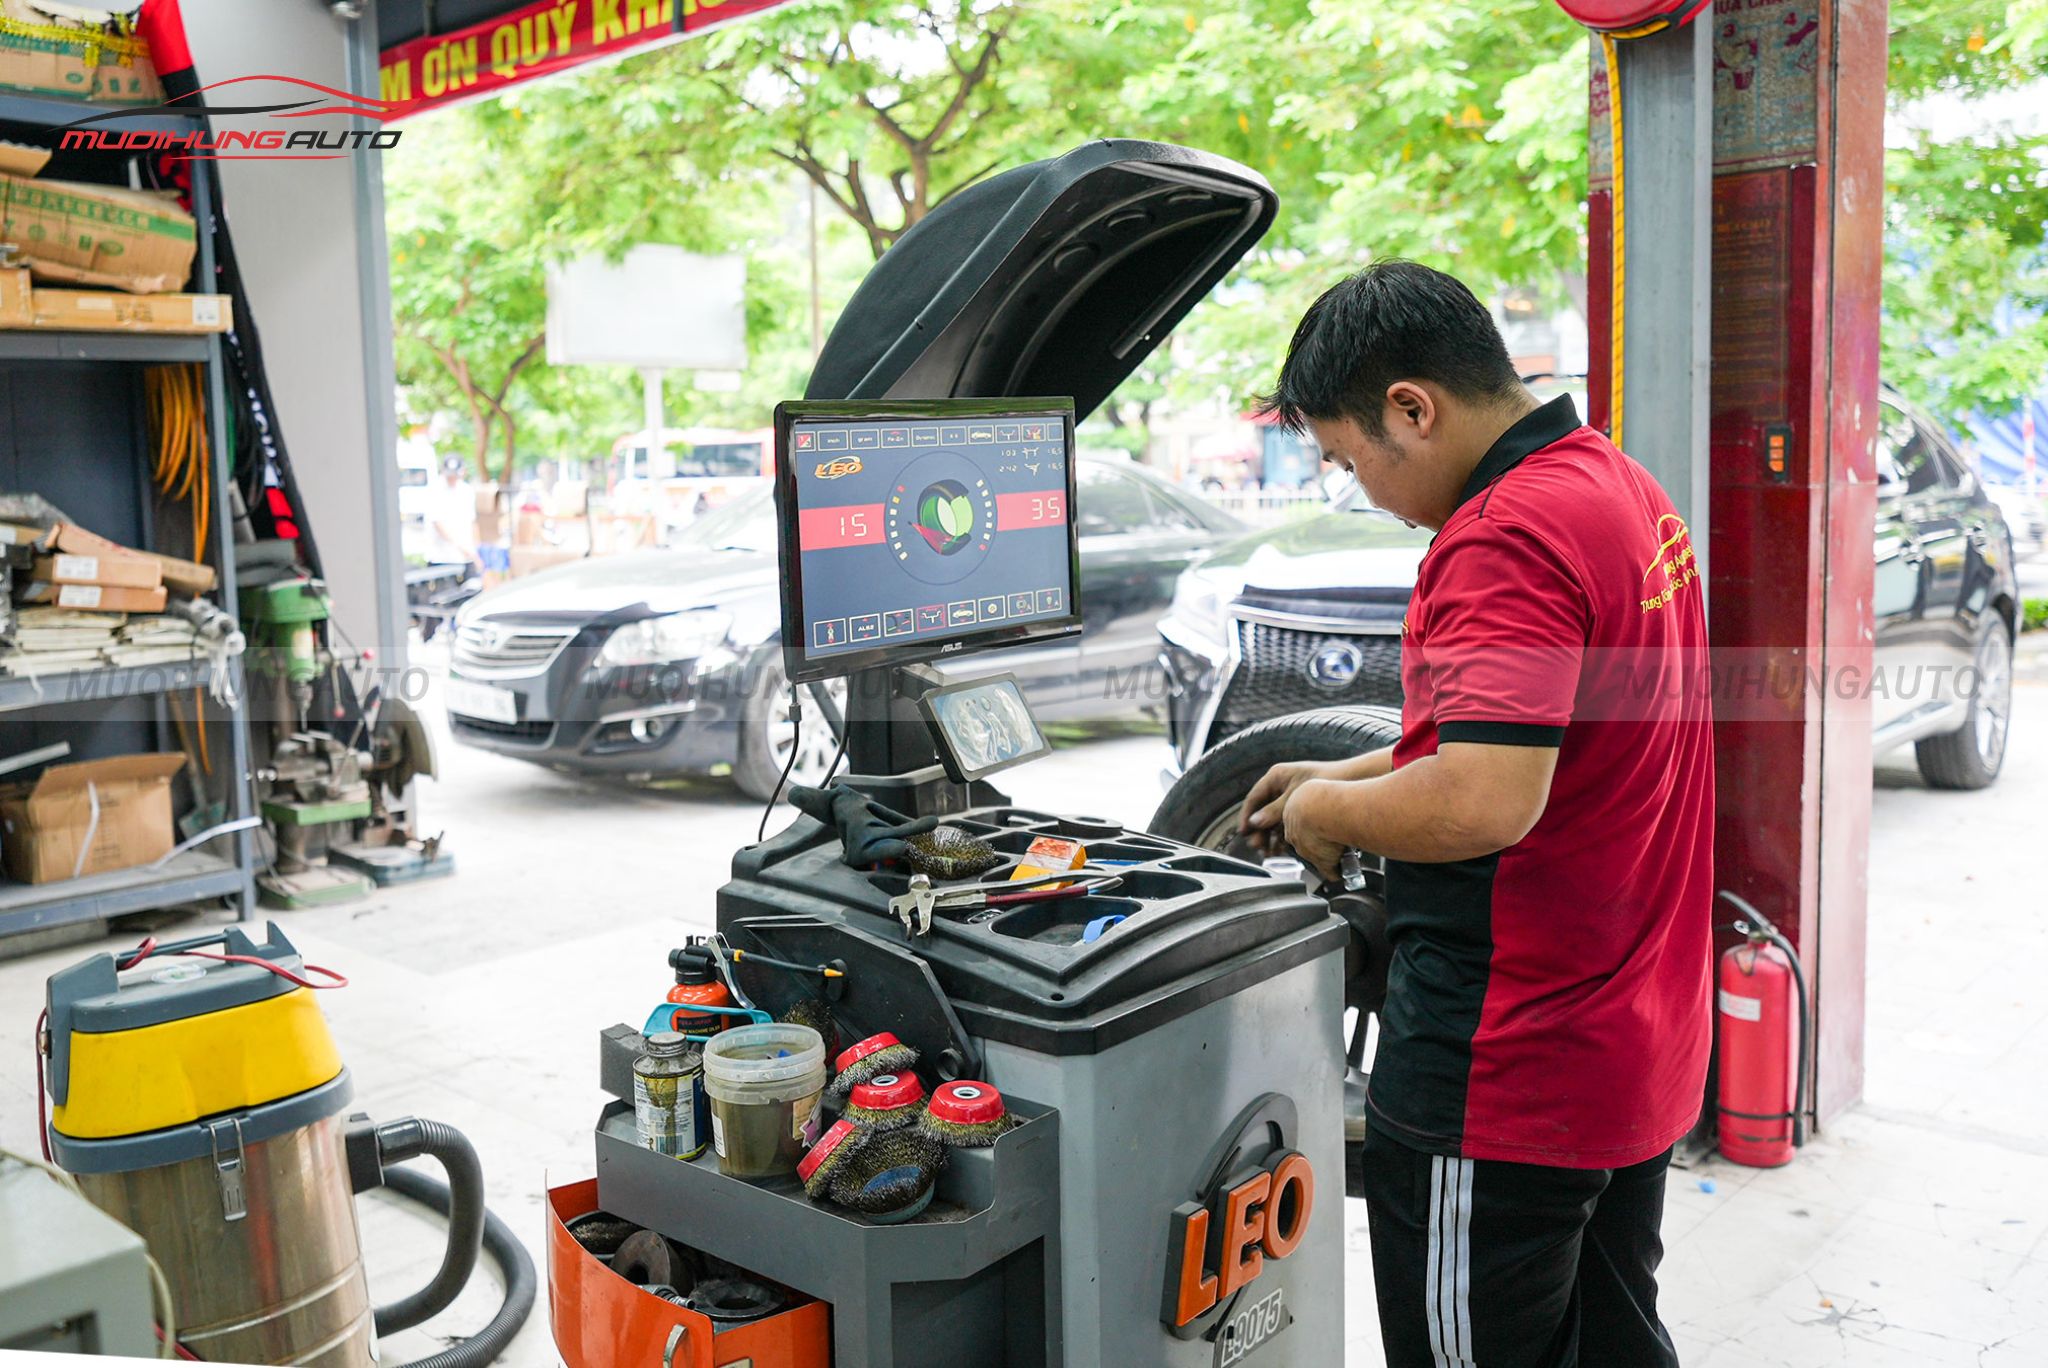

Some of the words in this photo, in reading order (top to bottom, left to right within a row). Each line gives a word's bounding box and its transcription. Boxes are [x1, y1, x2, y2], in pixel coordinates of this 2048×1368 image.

[422, 36, 479, 98] ƠN
[490, 0, 579, 79] QUÝ
[814, 460, 864, 479] LEO
[1031, 496, 1061, 521] 35
[839, 513, 867, 537] 15
[940, 641, 963, 655] ASUS
[1172, 1151, 1314, 1327] LEO
